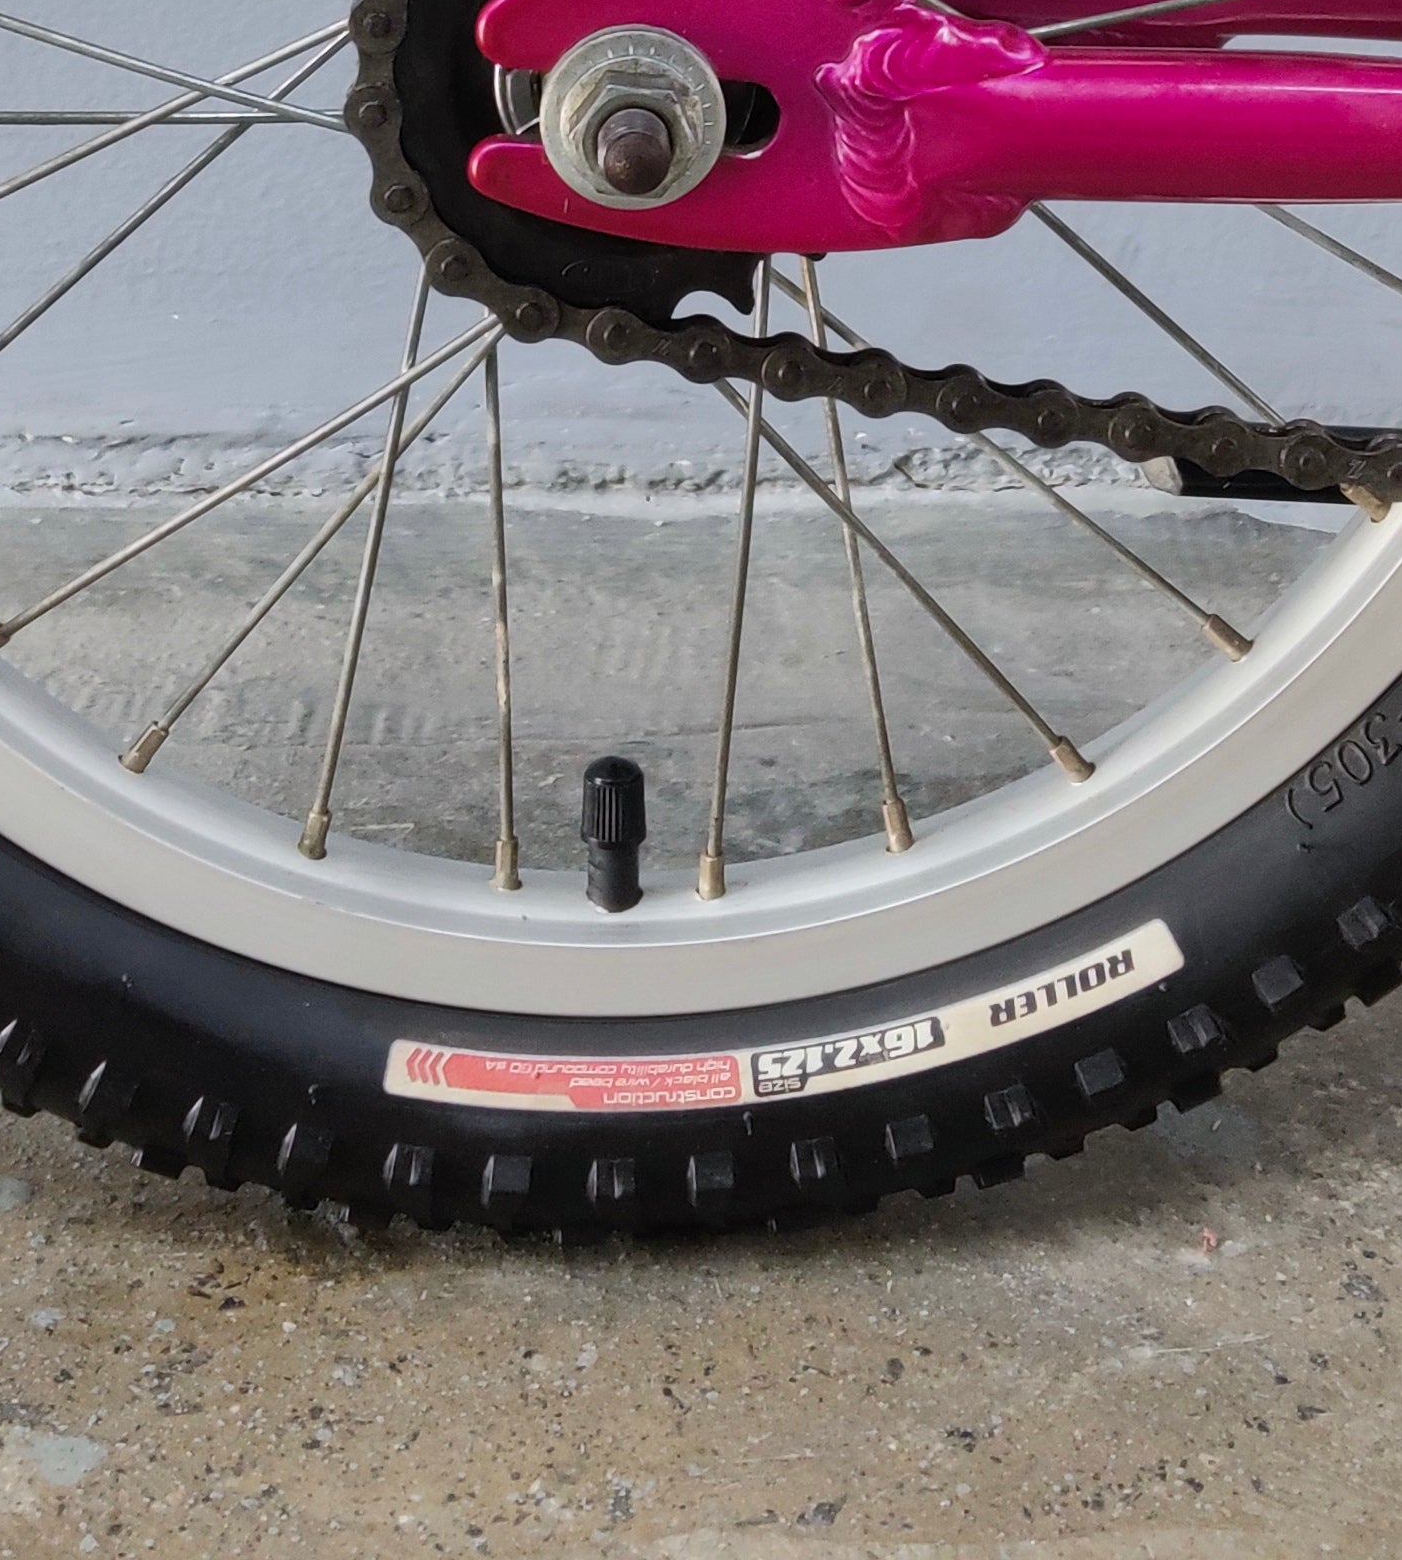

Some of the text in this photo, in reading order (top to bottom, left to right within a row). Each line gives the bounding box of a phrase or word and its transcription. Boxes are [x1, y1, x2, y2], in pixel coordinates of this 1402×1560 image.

[989, 948, 1137, 1028] ROLLER
[756, 1019, 938, 1082] 16x2.125
[620, 1059, 694, 1076] durability
[696, 1055, 731, 1072] high
[568, 1075, 613, 1089] bead
[614, 1075, 650, 1089] wire
[664, 1074, 709, 1089] black
[710, 1072, 733, 1087] all
[758, 1077, 803, 1093] size
[602, 1086, 737, 1107] construction
